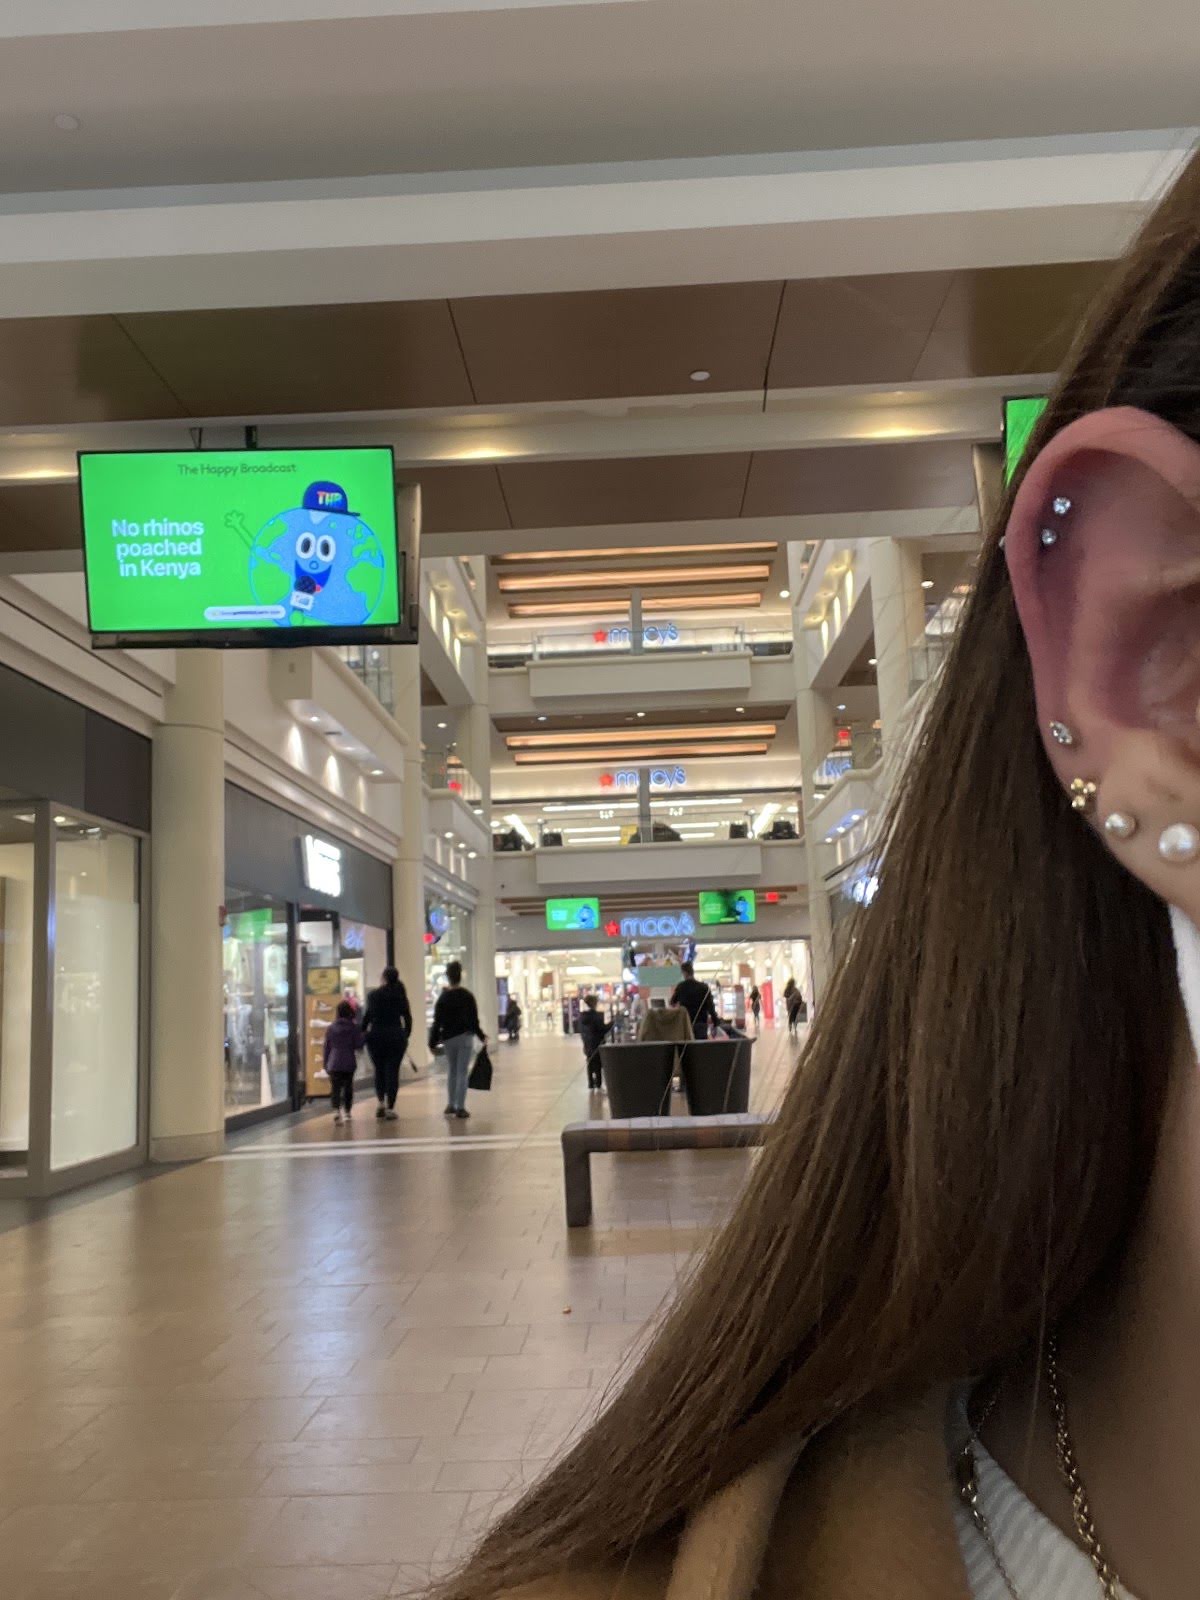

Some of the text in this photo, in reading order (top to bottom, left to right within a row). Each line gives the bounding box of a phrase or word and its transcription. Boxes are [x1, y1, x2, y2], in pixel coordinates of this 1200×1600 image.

[177, 463, 297, 477] The Happy Broadcast
[111, 518, 204, 537] No rhinos
[116, 538, 202, 560] poached
[119, 559, 201, 580] in Kenya
[608, 622, 678, 644] mcy's
[616, 765, 686, 789] mcy's
